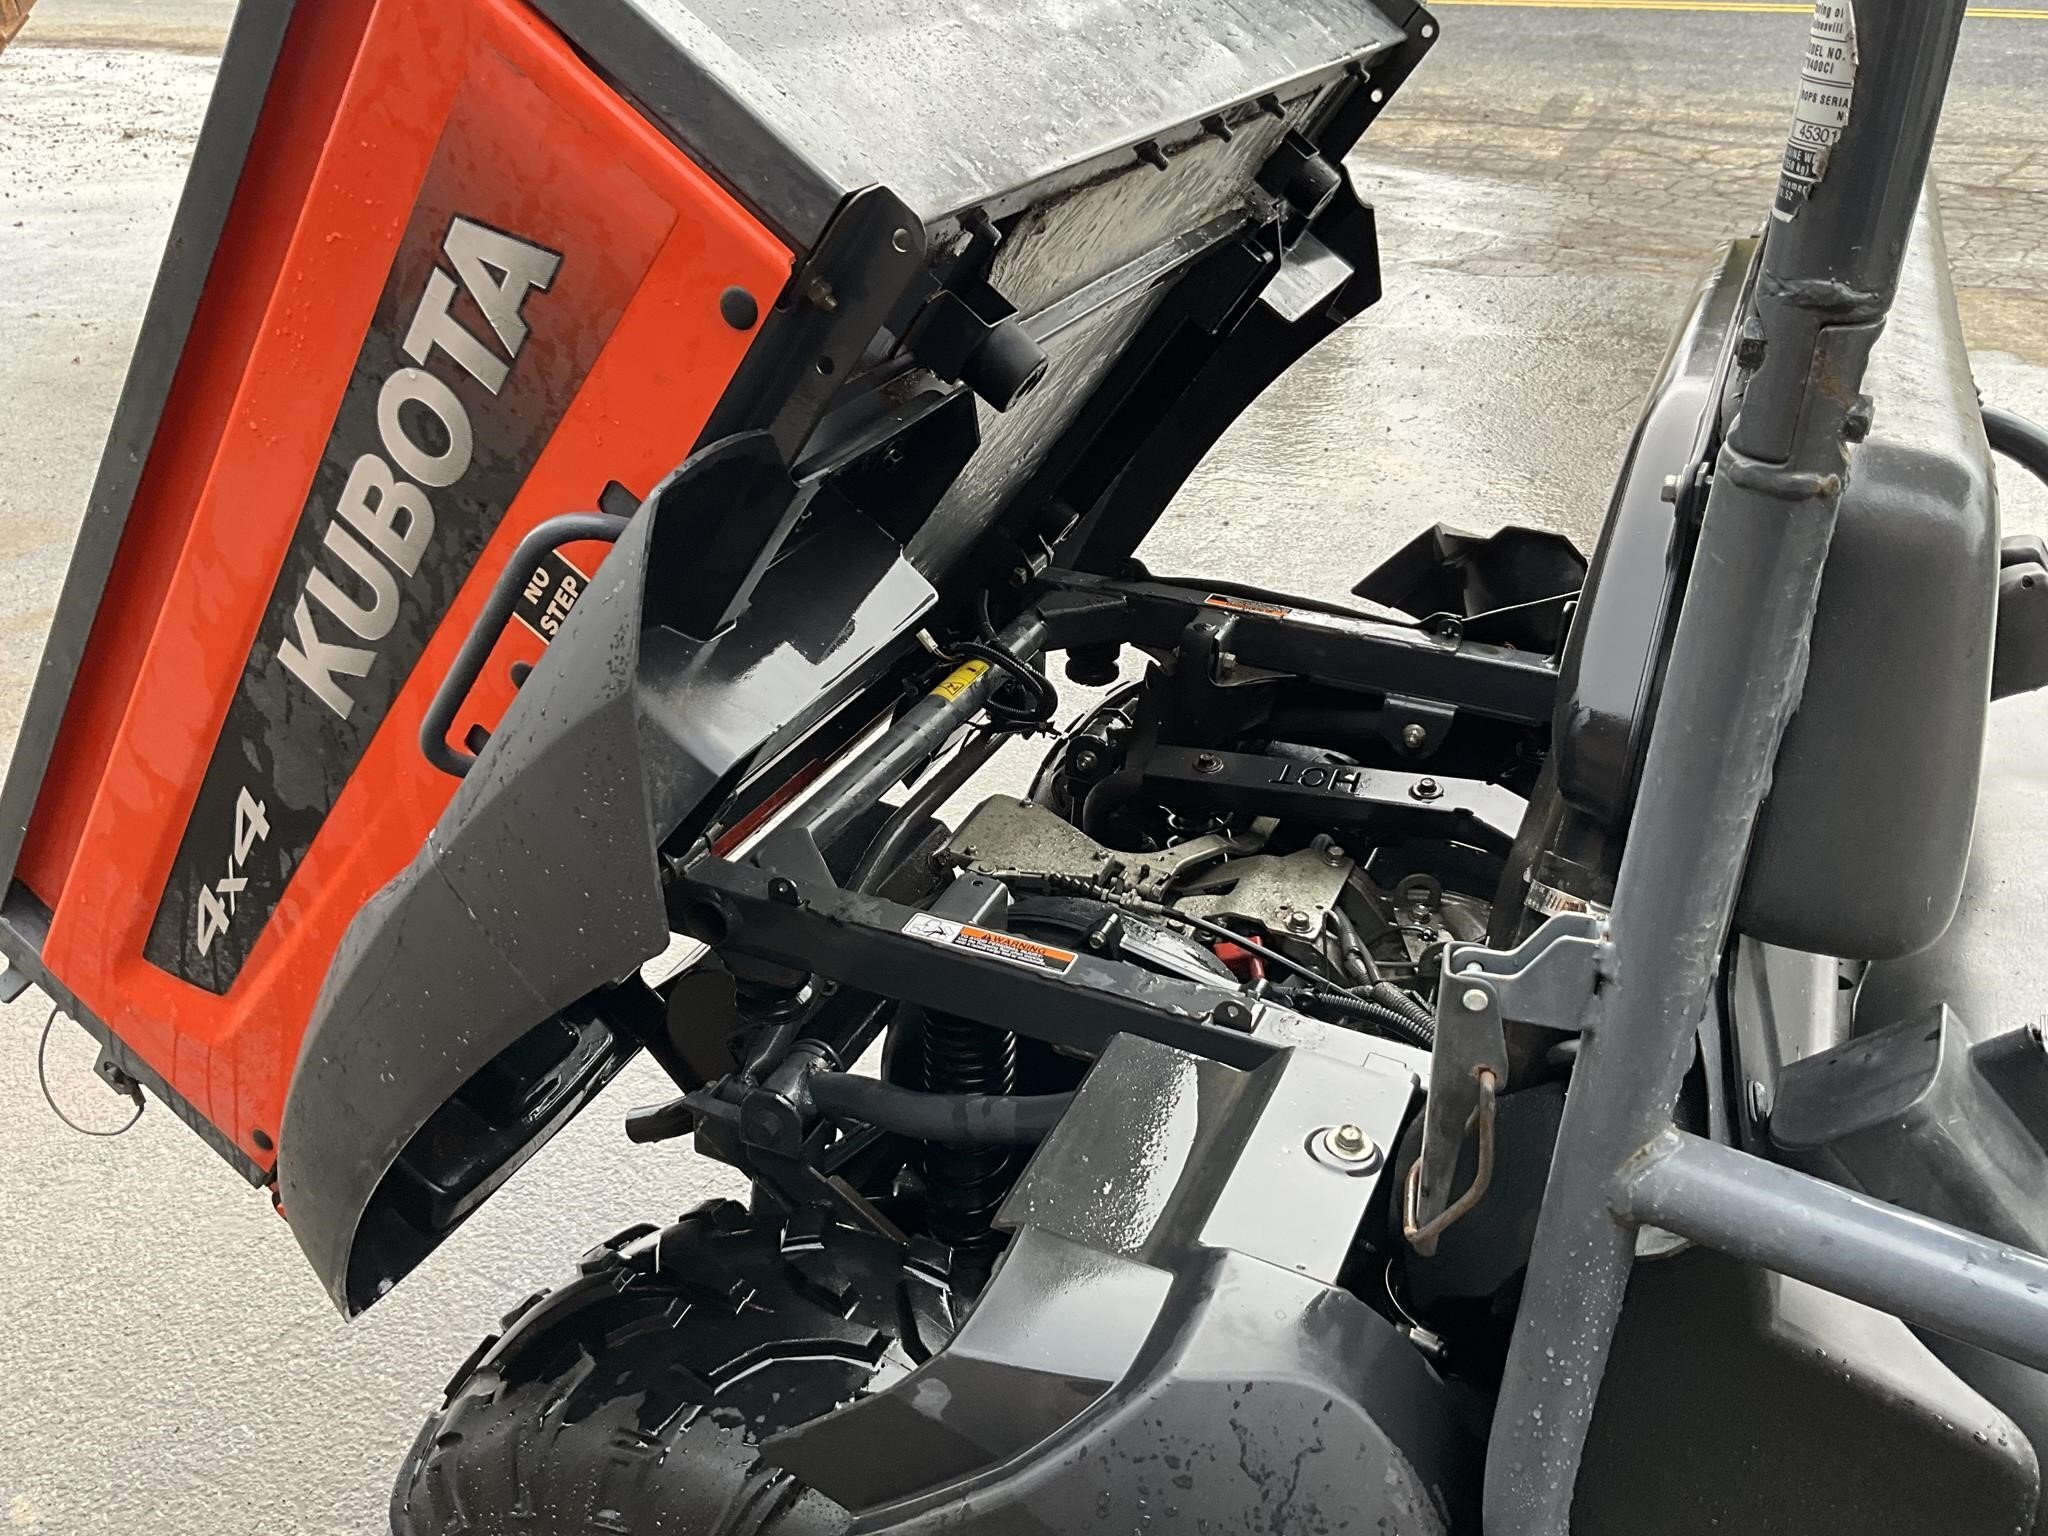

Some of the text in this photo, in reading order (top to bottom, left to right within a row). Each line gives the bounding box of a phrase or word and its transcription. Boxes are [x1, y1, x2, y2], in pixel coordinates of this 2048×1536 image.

[1827, 47, 1846, 61] NO.
[1819, 94, 1849, 108] SERIA
[277, 216, 563, 720] KUBOTA
[523, 566, 551, 605] NO
[540, 575, 579, 635] STEP
[1268, 763, 1362, 794] HOT
[994, 936, 1046, 954] WARNING
